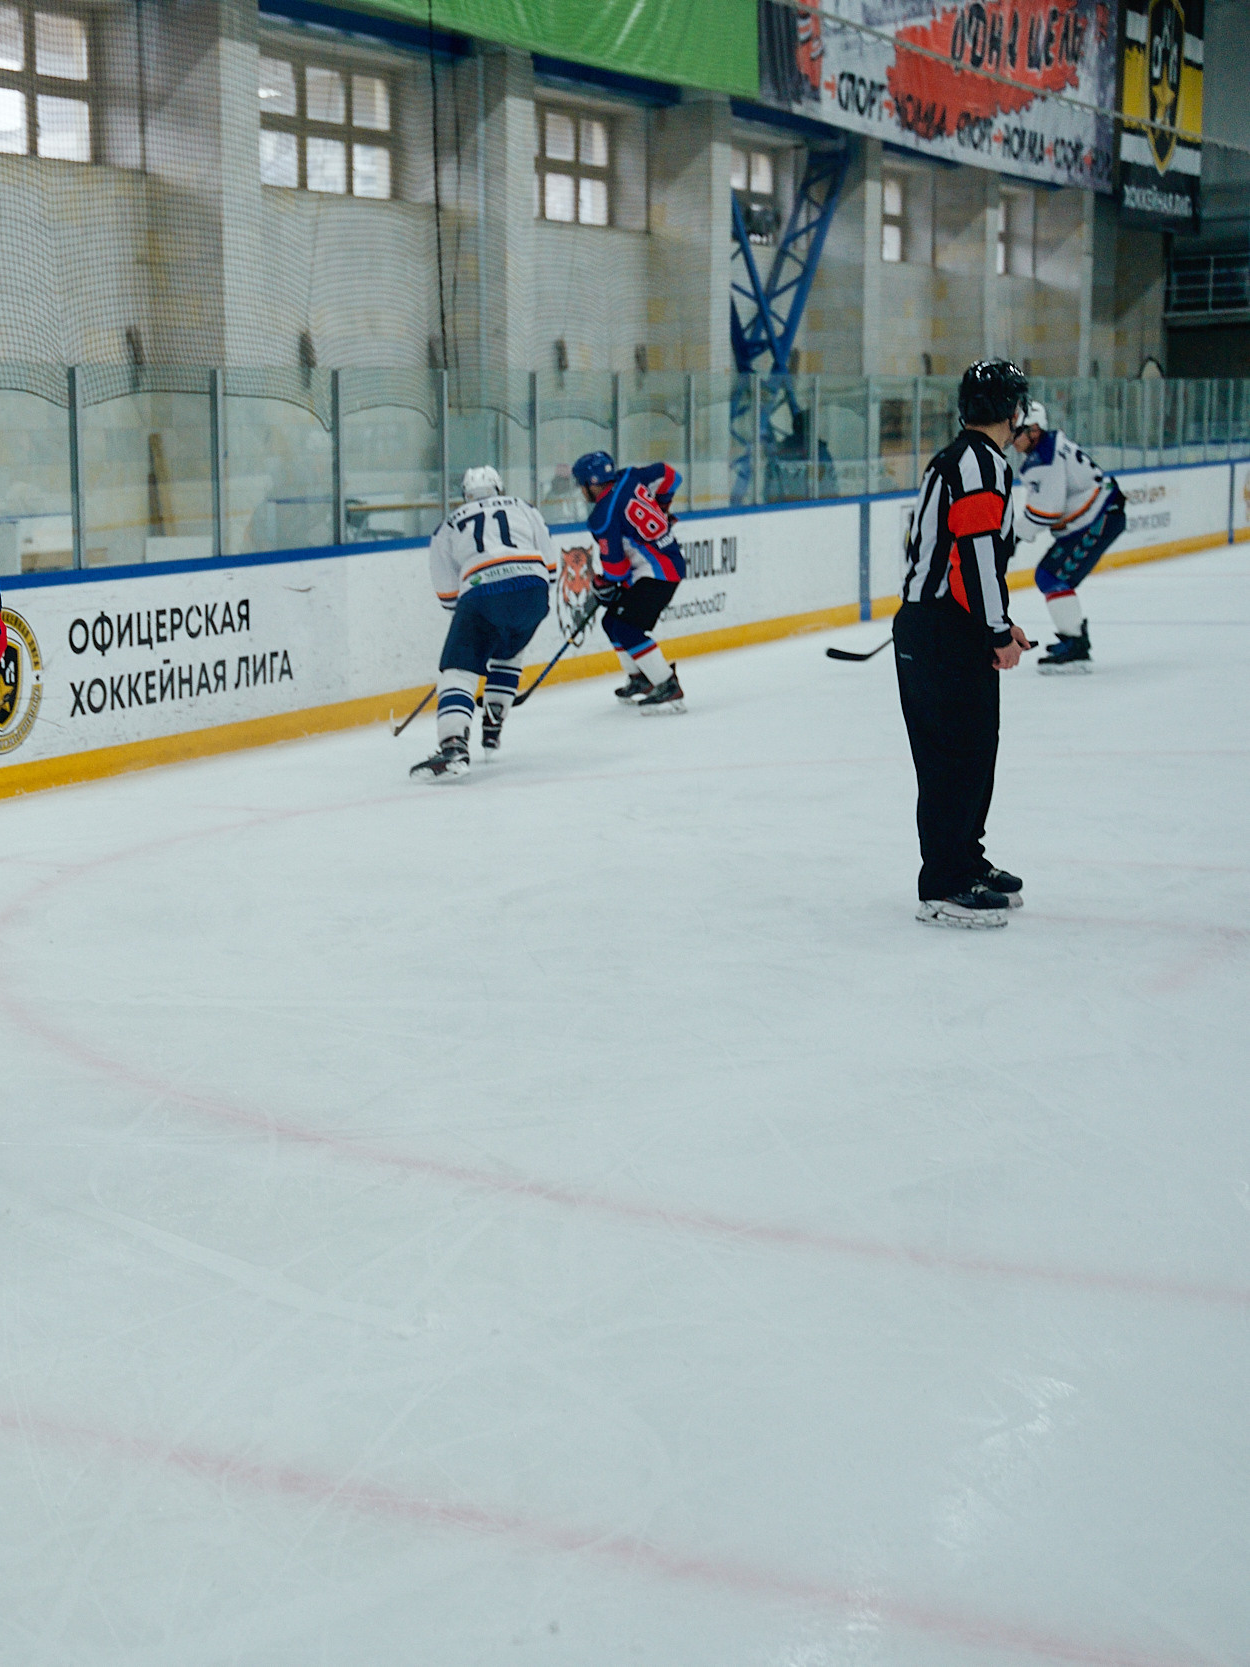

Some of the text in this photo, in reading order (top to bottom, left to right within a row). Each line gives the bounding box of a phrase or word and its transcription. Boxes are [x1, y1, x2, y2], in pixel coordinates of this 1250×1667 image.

[456, 509, 518, 554] 71
[68, 599, 250, 656] ОФИЦЕРСКАЯ
[69, 659, 226, 717] ХОККЕЙНАЯ
[234, 650, 293, 689] ЛИГА
